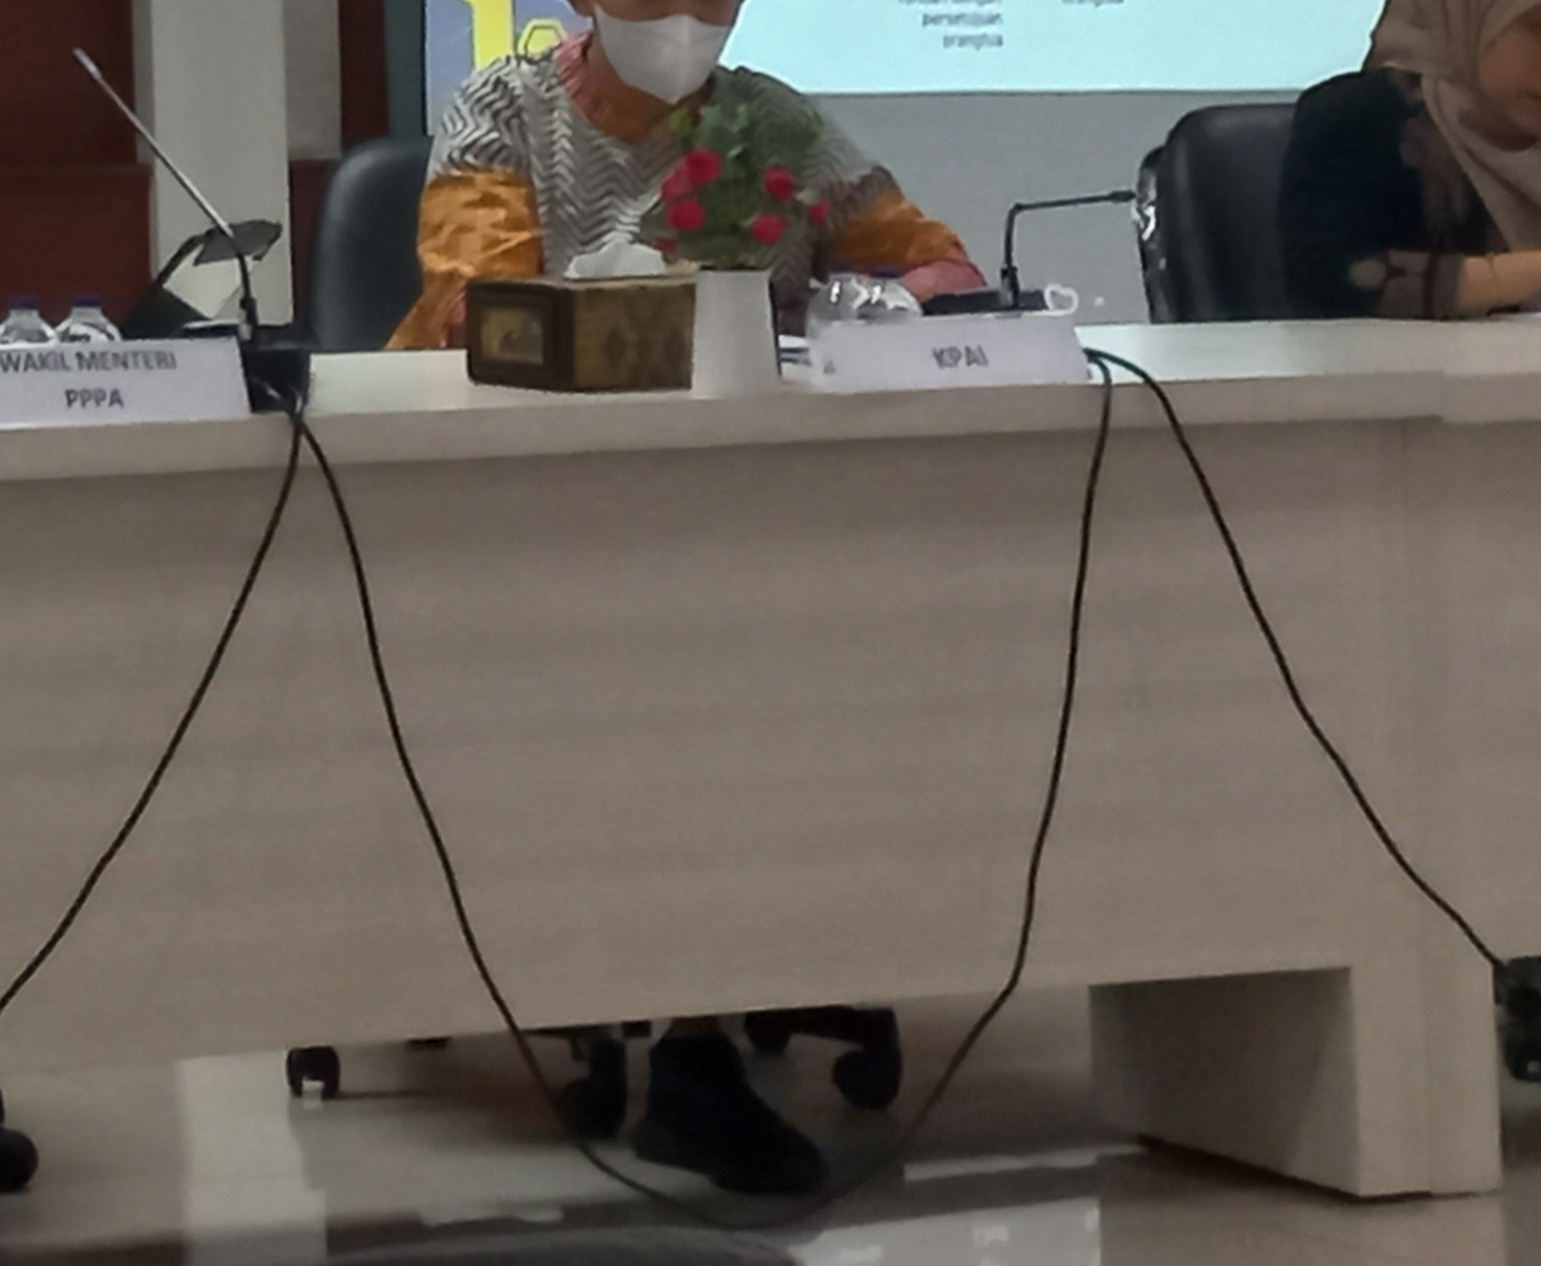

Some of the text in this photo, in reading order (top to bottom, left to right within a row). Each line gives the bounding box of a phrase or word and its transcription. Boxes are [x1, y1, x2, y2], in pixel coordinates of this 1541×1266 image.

[75, 349, 177, 371] MENTERI
[932, 345, 988, 369] KPAI
[64, 388, 124, 408] PPPA
